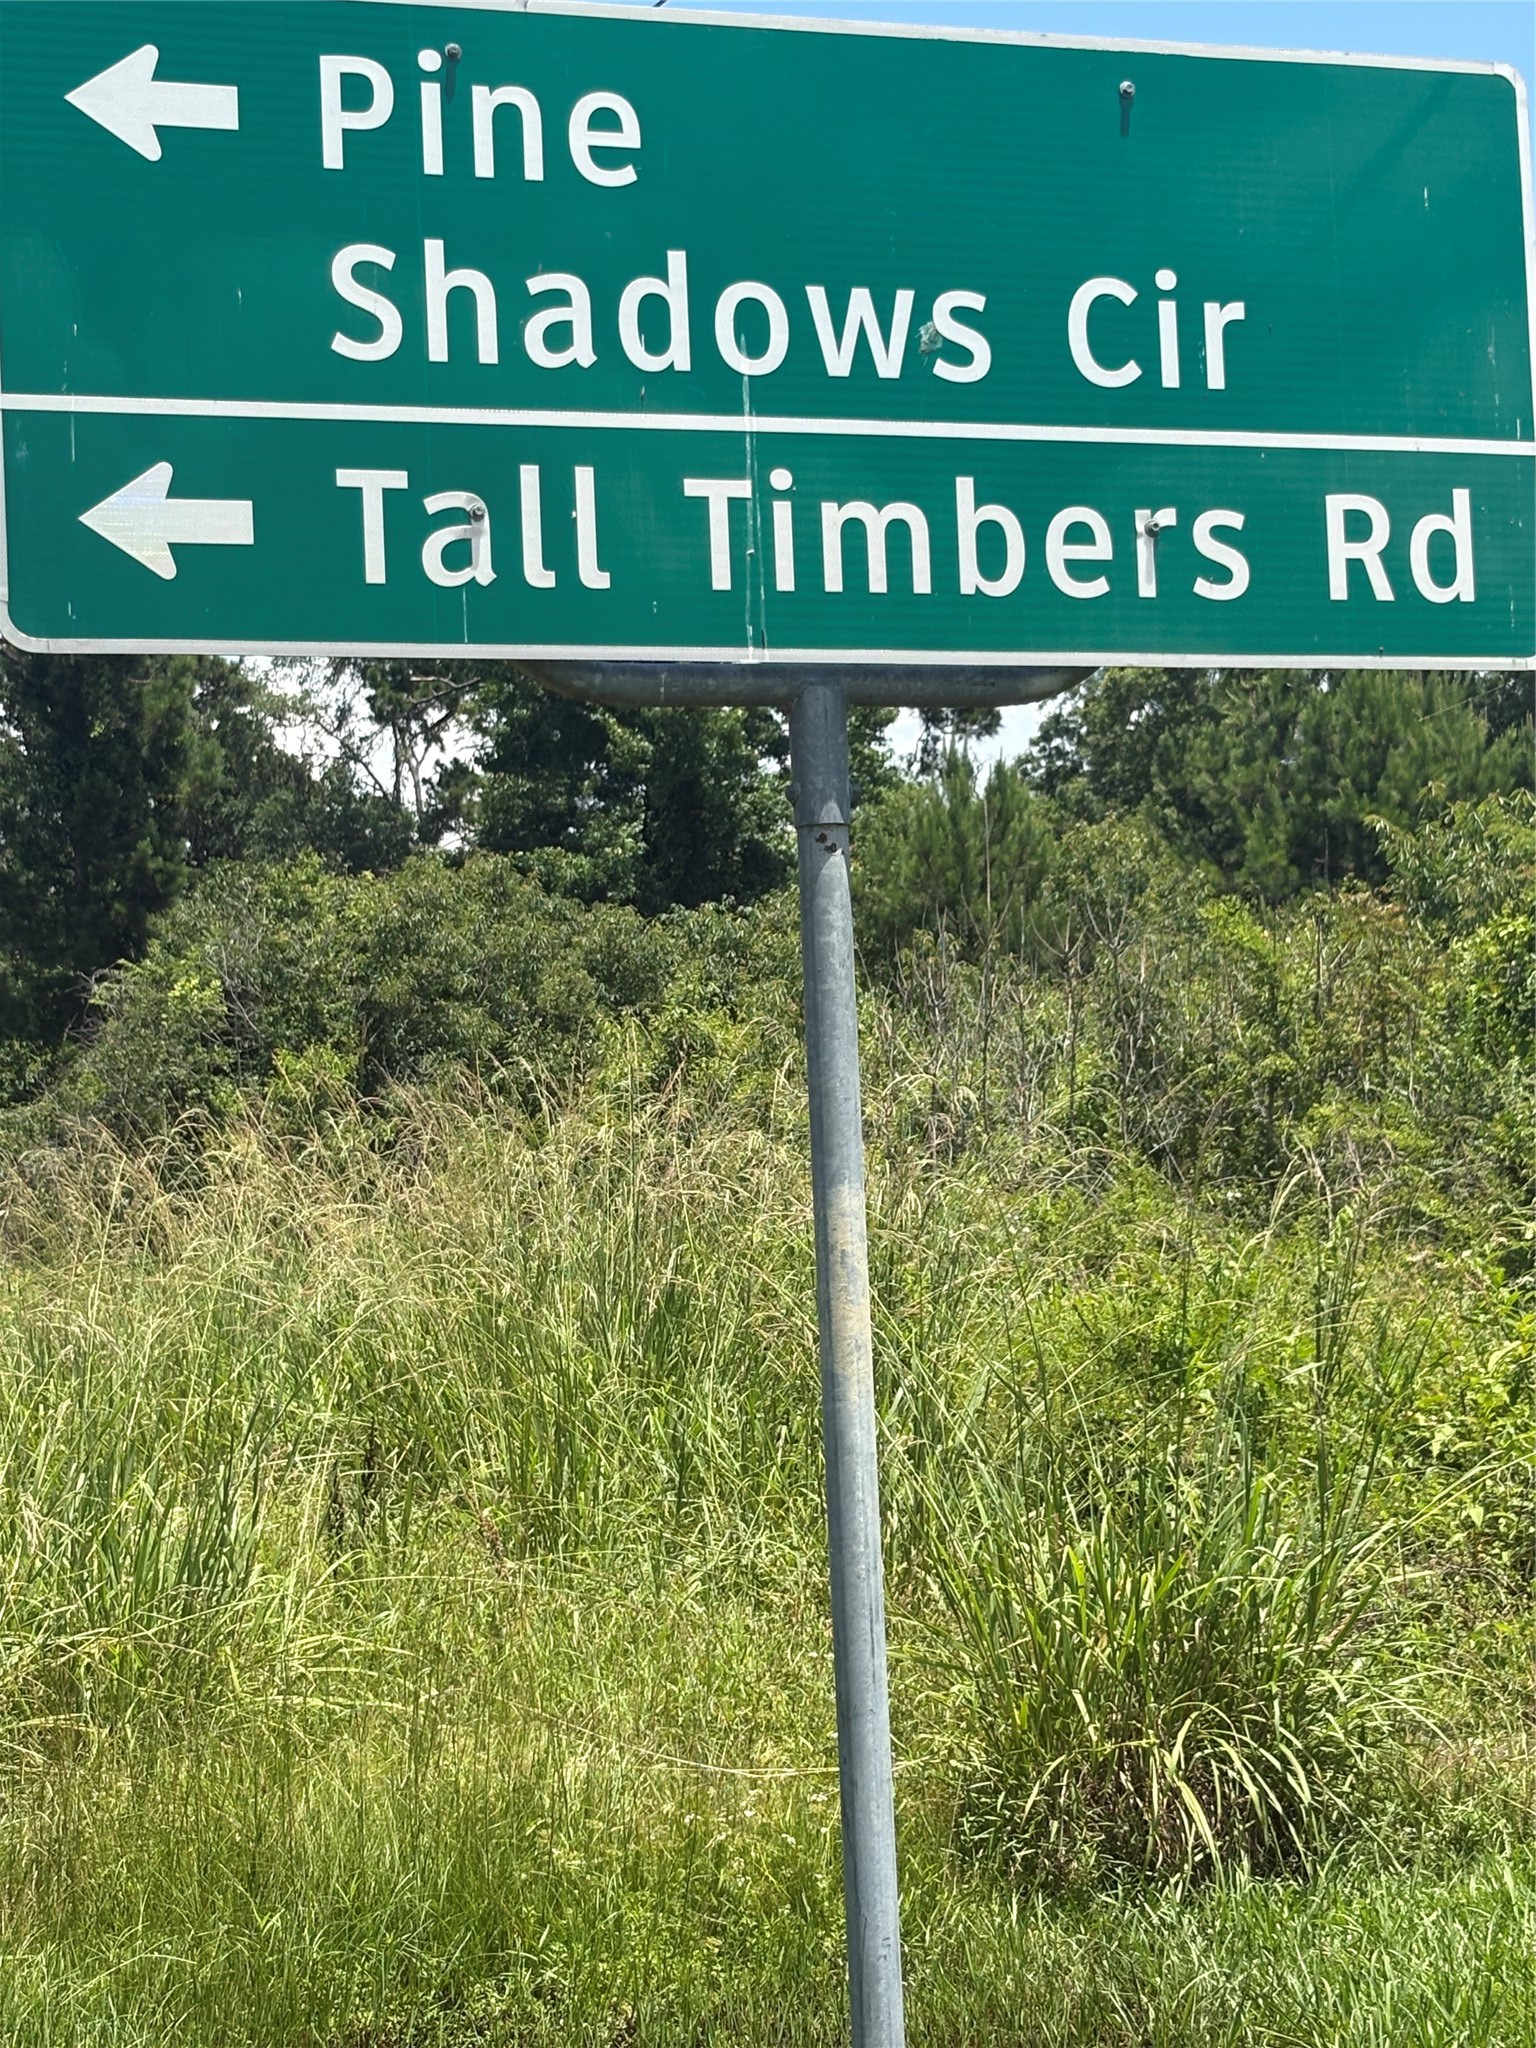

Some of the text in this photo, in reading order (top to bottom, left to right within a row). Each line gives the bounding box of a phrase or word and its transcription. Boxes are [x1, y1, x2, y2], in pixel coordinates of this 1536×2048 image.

[319, 50, 642, 188] Pine
[330, 238, 1246, 390] Shadows Cir
[335, 464, 1475, 604] Tall Timbers Rd
